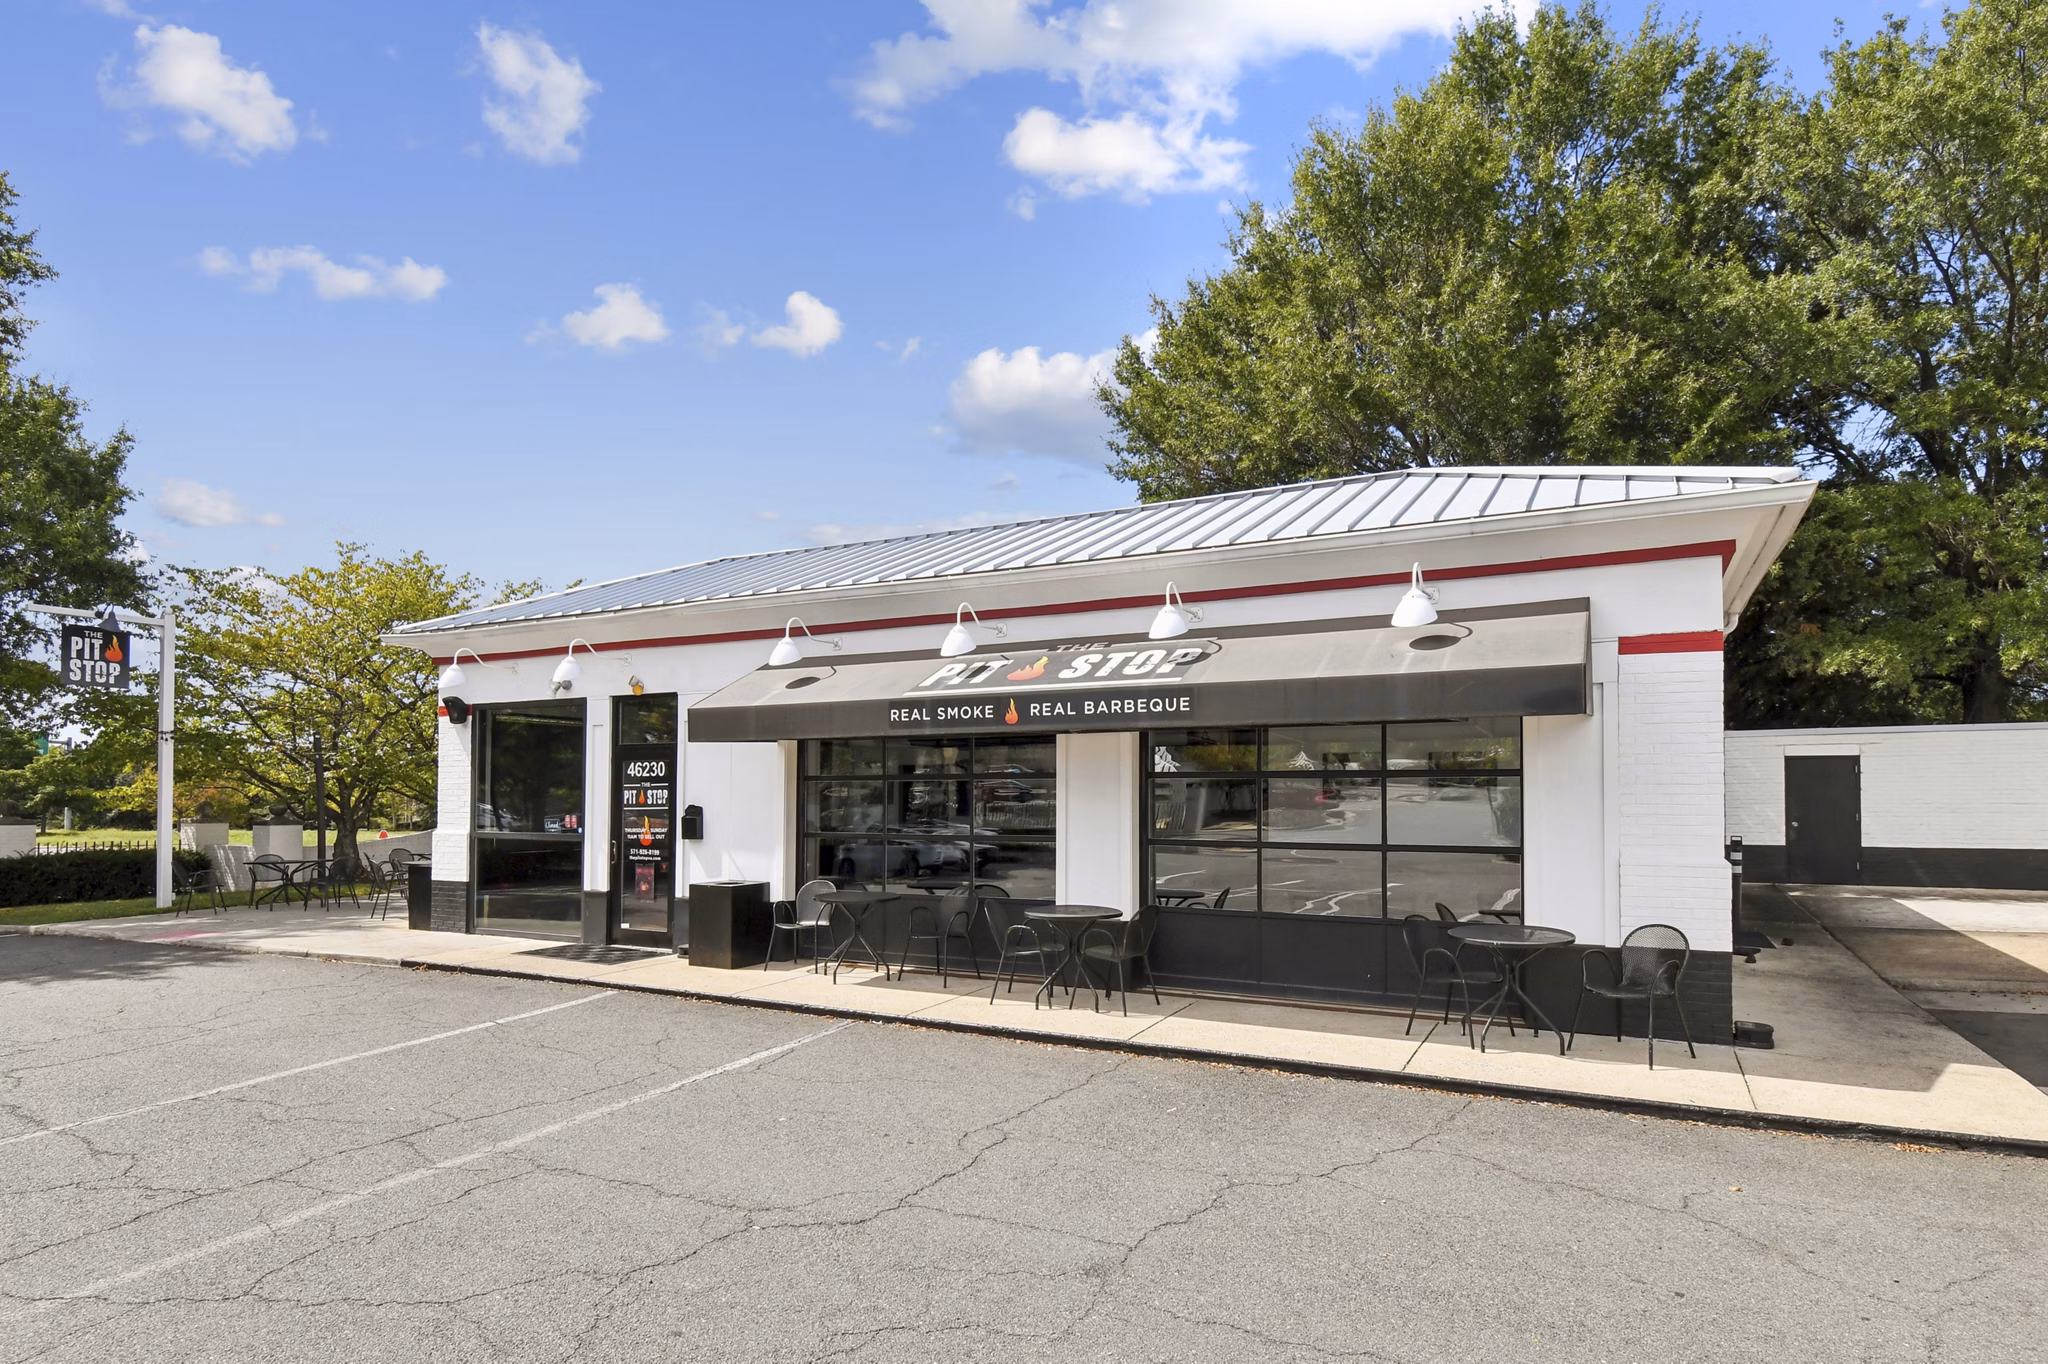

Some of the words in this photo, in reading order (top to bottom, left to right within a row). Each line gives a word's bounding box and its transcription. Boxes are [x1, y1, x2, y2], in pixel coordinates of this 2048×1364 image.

[84, 630, 103, 638] THE
[71, 636, 103, 660] PIT
[1056, 641, 1109, 653] THE
[69, 659, 121, 684] STOP
[918, 659, 1015, 687] PIT
[1057, 648, 1203, 679] STOP
[890, 708, 931, 721] REAL
[937, 705, 994, 720] SMOKE
[1030, 702, 1076, 717] REAL
[1084, 697, 1190, 715] BARBEQUE
[627, 761, 666, 777] 46230
[624, 790, 637, 804] PIT
[647, 789, 669, 804] STOP
